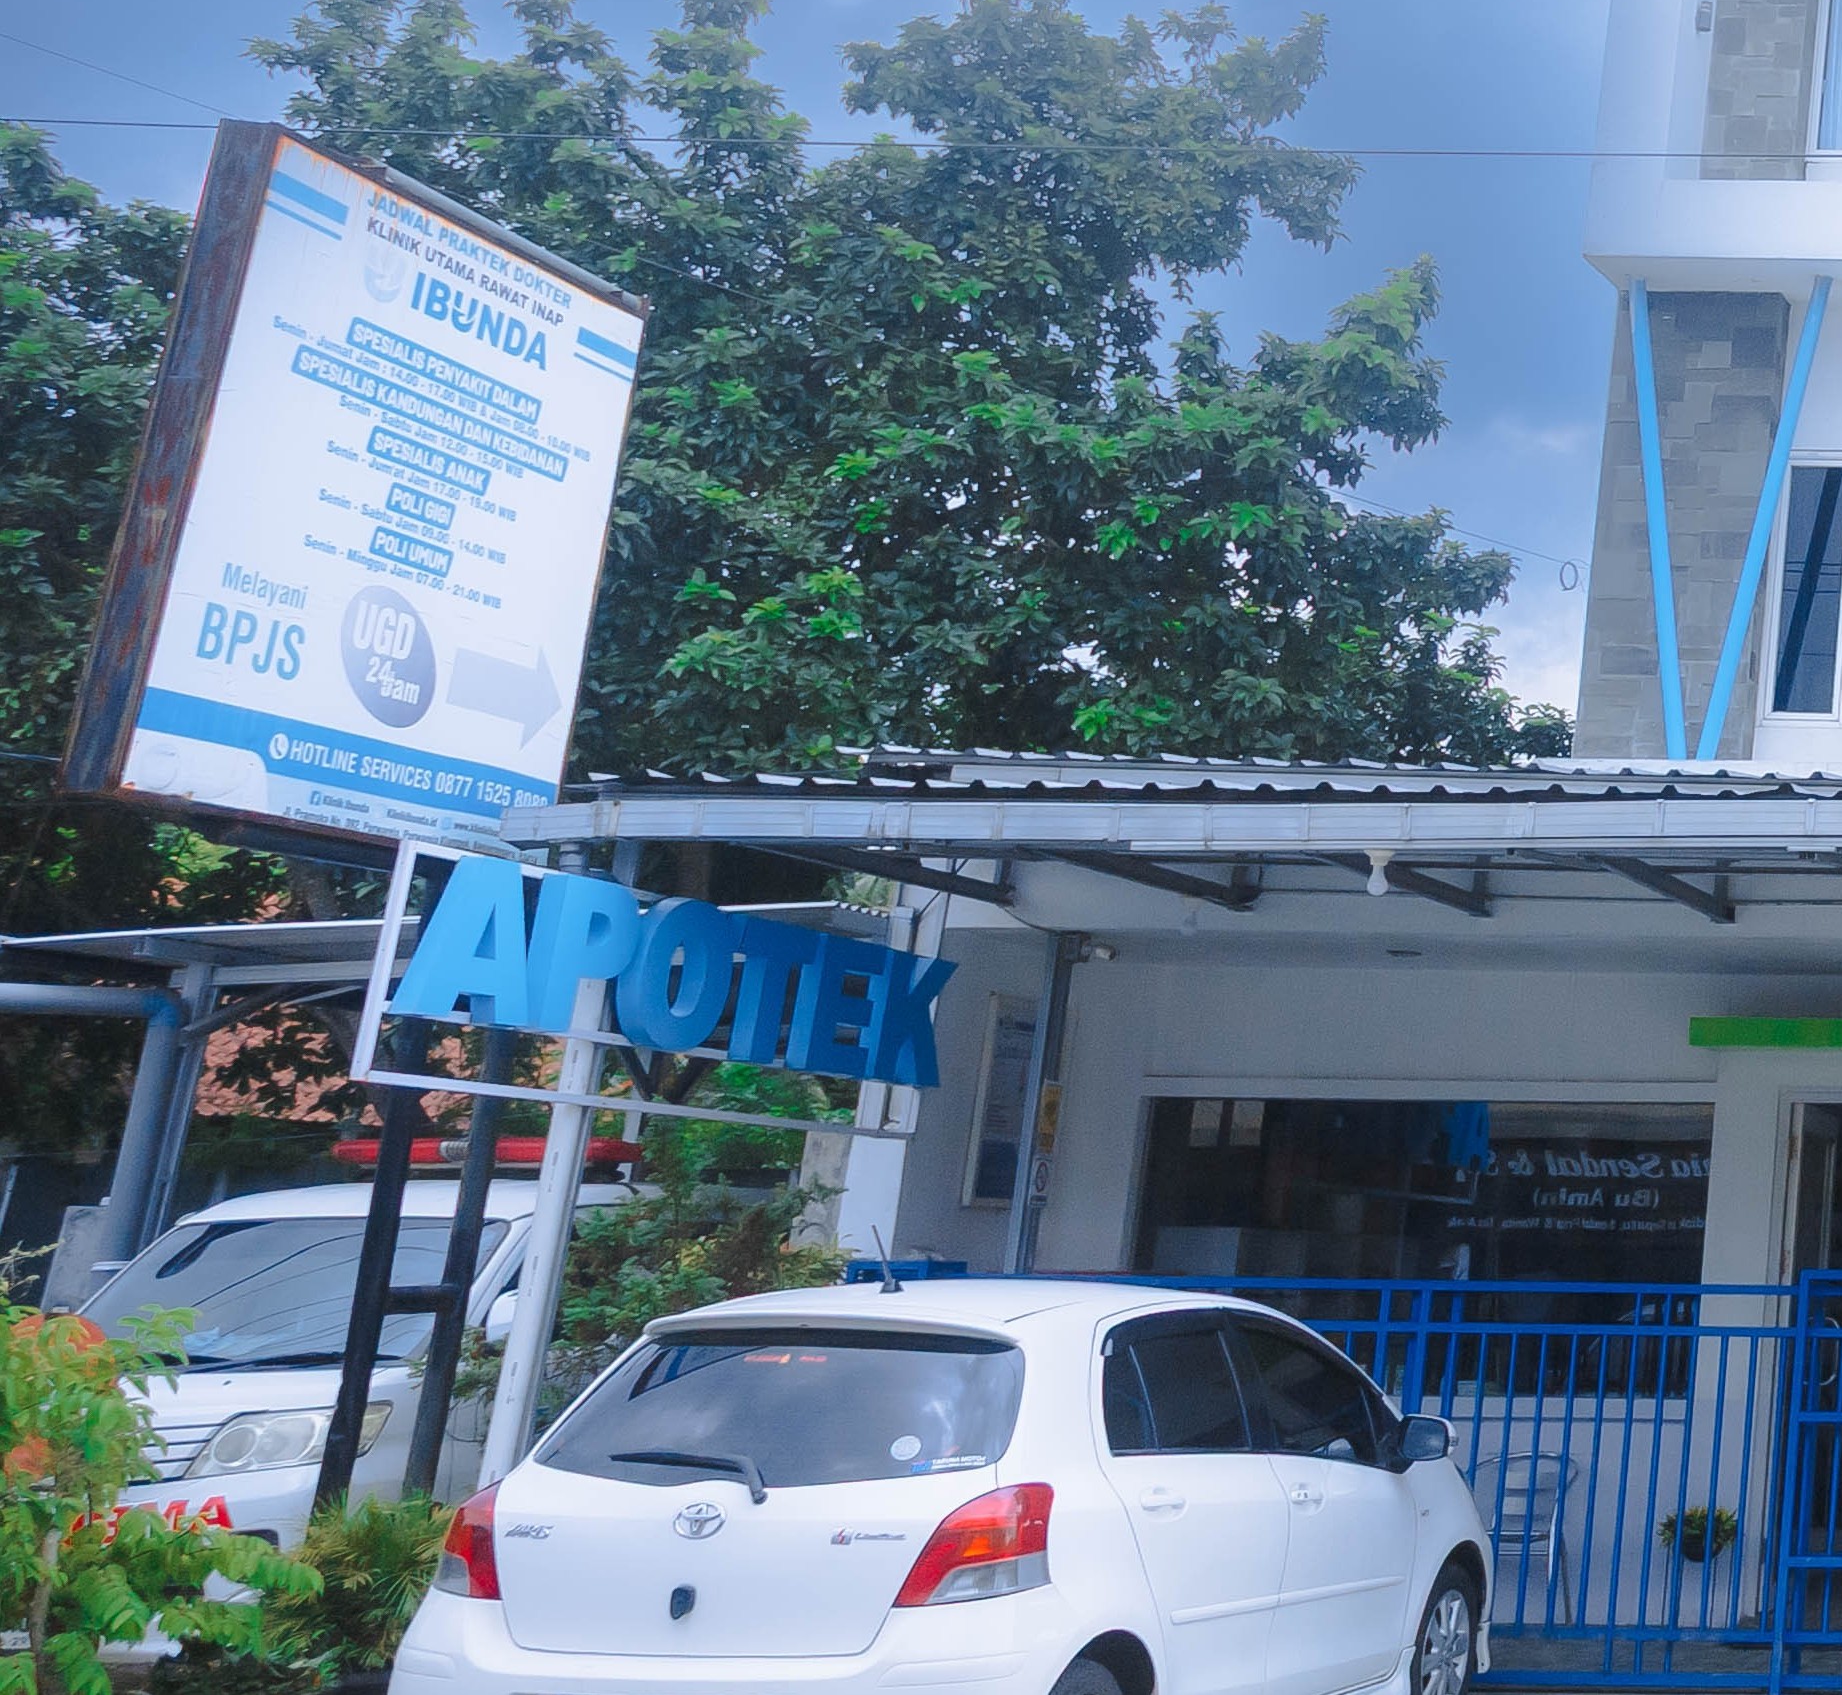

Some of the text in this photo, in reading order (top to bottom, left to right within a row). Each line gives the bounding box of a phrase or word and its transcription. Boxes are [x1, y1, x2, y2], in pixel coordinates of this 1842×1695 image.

[366, 216, 564, 326] KLINIK UTAMA RAWAT INAP
[367, 196, 571, 308] JADWAL PRAKTEK DOKTER
[411, 273, 545, 368] IBUNDA
[272, 314, 306, 338] Senin
[355, 352, 380, 371] Jam
[457, 394, 477, 412] WIB
[489, 410, 511, 427] Jam
[573, 447, 590, 462] WIB
[352, 323, 537, 418] SPESIALIS PENYAKIT DALAM
[299, 351, 563, 475] SPESIALIS KANDUNGAN DAN KEBIDANAN
[338, 393, 371, 416] Senin
[380, 410, 411, 433] Sabtu
[413, 425, 437, 443] Jam
[504, 462, 523, 478] WIB
[326, 439, 359, 462] Senin
[406, 471, 430, 489] Jam
[498, 506, 515, 522] WIB
[373, 432, 484, 489] SPESIALIS ANAK
[317, 487, 352, 510] Senin
[360, 502, 393, 524] Sabtu
[394, 516, 419, 532] Jam
[487, 549, 505, 564] WIB
[390, 487, 451, 524] POLI GIGI
[221, 562, 307, 608] Melayani
[303, 533, 337, 555] Senin
[346, 548, 387, 572] Minggu
[388, 563, 413, 579] Jam
[482, 594, 501, 609] WIB
[374, 531, 448, 571] POLI UMUM
[196, 602, 304, 679] BPJS
[352, 599, 415, 658] UGD
[365, 655, 391, 685] 24
[289, 740, 357, 773] HOTLINE
[360, 755, 432, 789] SERVICES
[434, 771, 473, 795] 0877
[477, 780, 511, 806] 1525
[387, 855, 957, 1088] APOTEK
